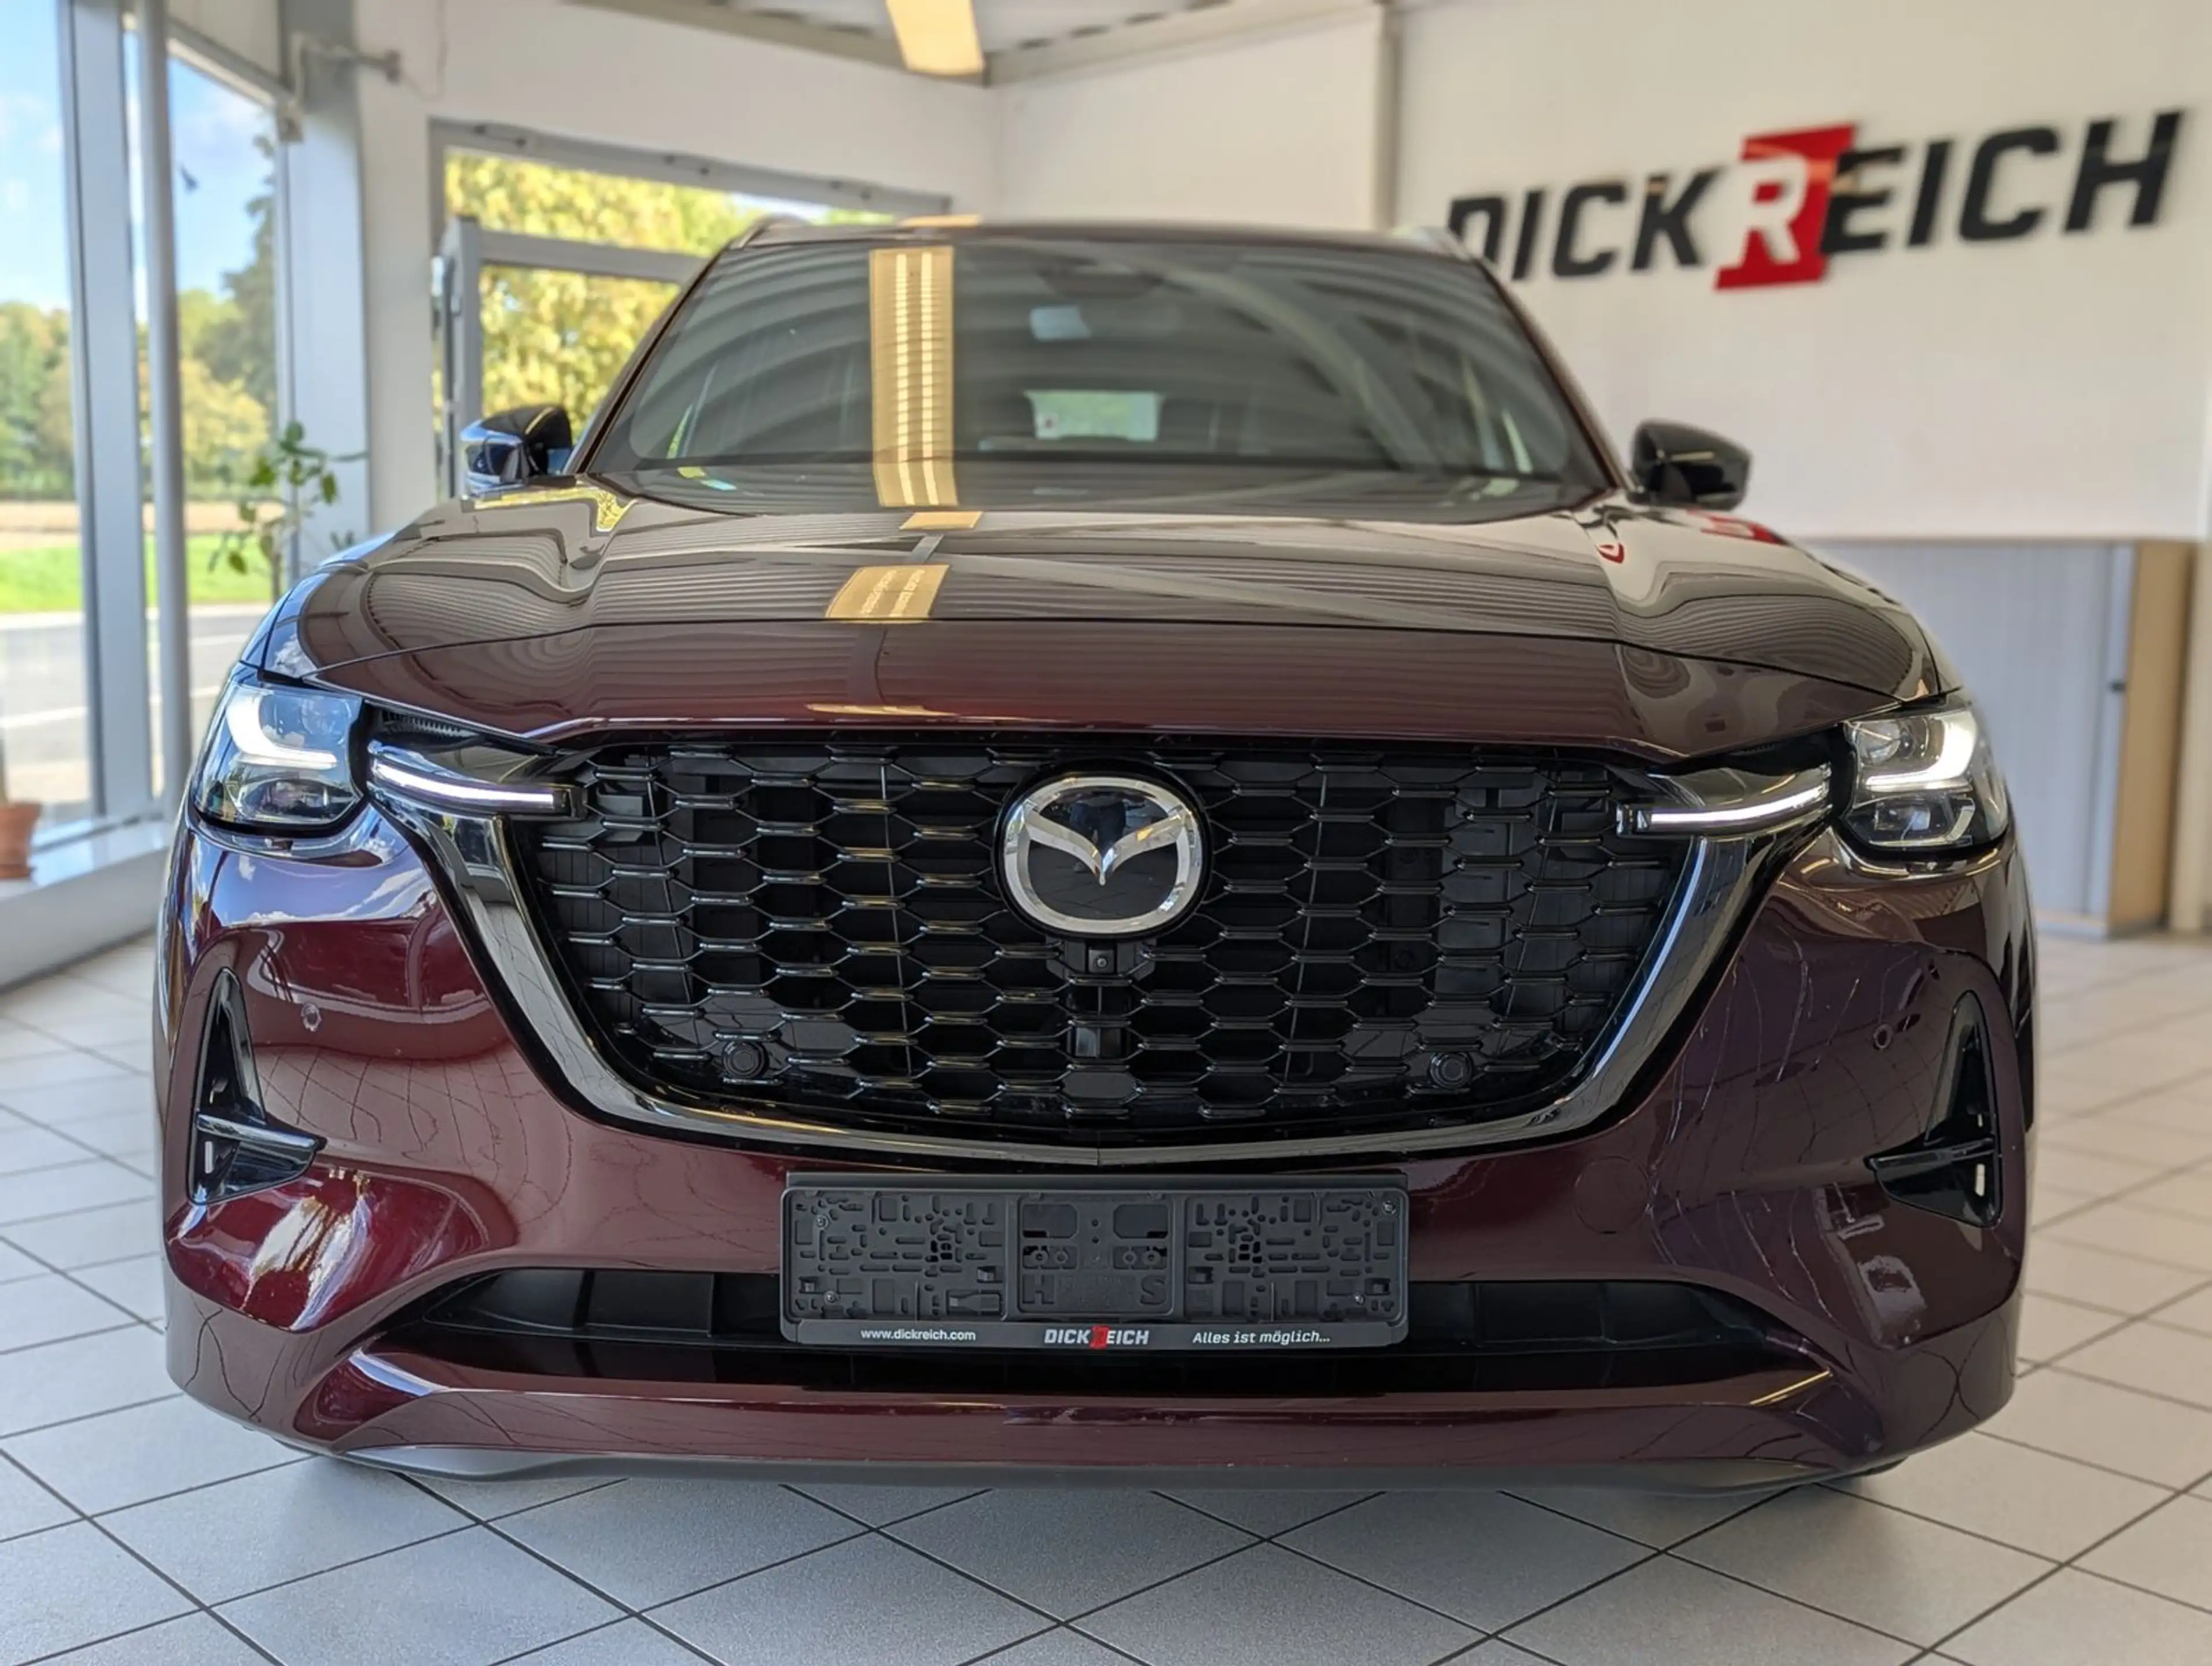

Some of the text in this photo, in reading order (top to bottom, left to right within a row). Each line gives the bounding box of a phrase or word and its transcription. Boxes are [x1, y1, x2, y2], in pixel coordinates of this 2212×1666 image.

[1447, 111, 2182, 290] DICKREICH
[860, 1329, 976, 1341] www.dickreich.com
[1193, 1330, 1331, 1346] Alles ist möglich...
